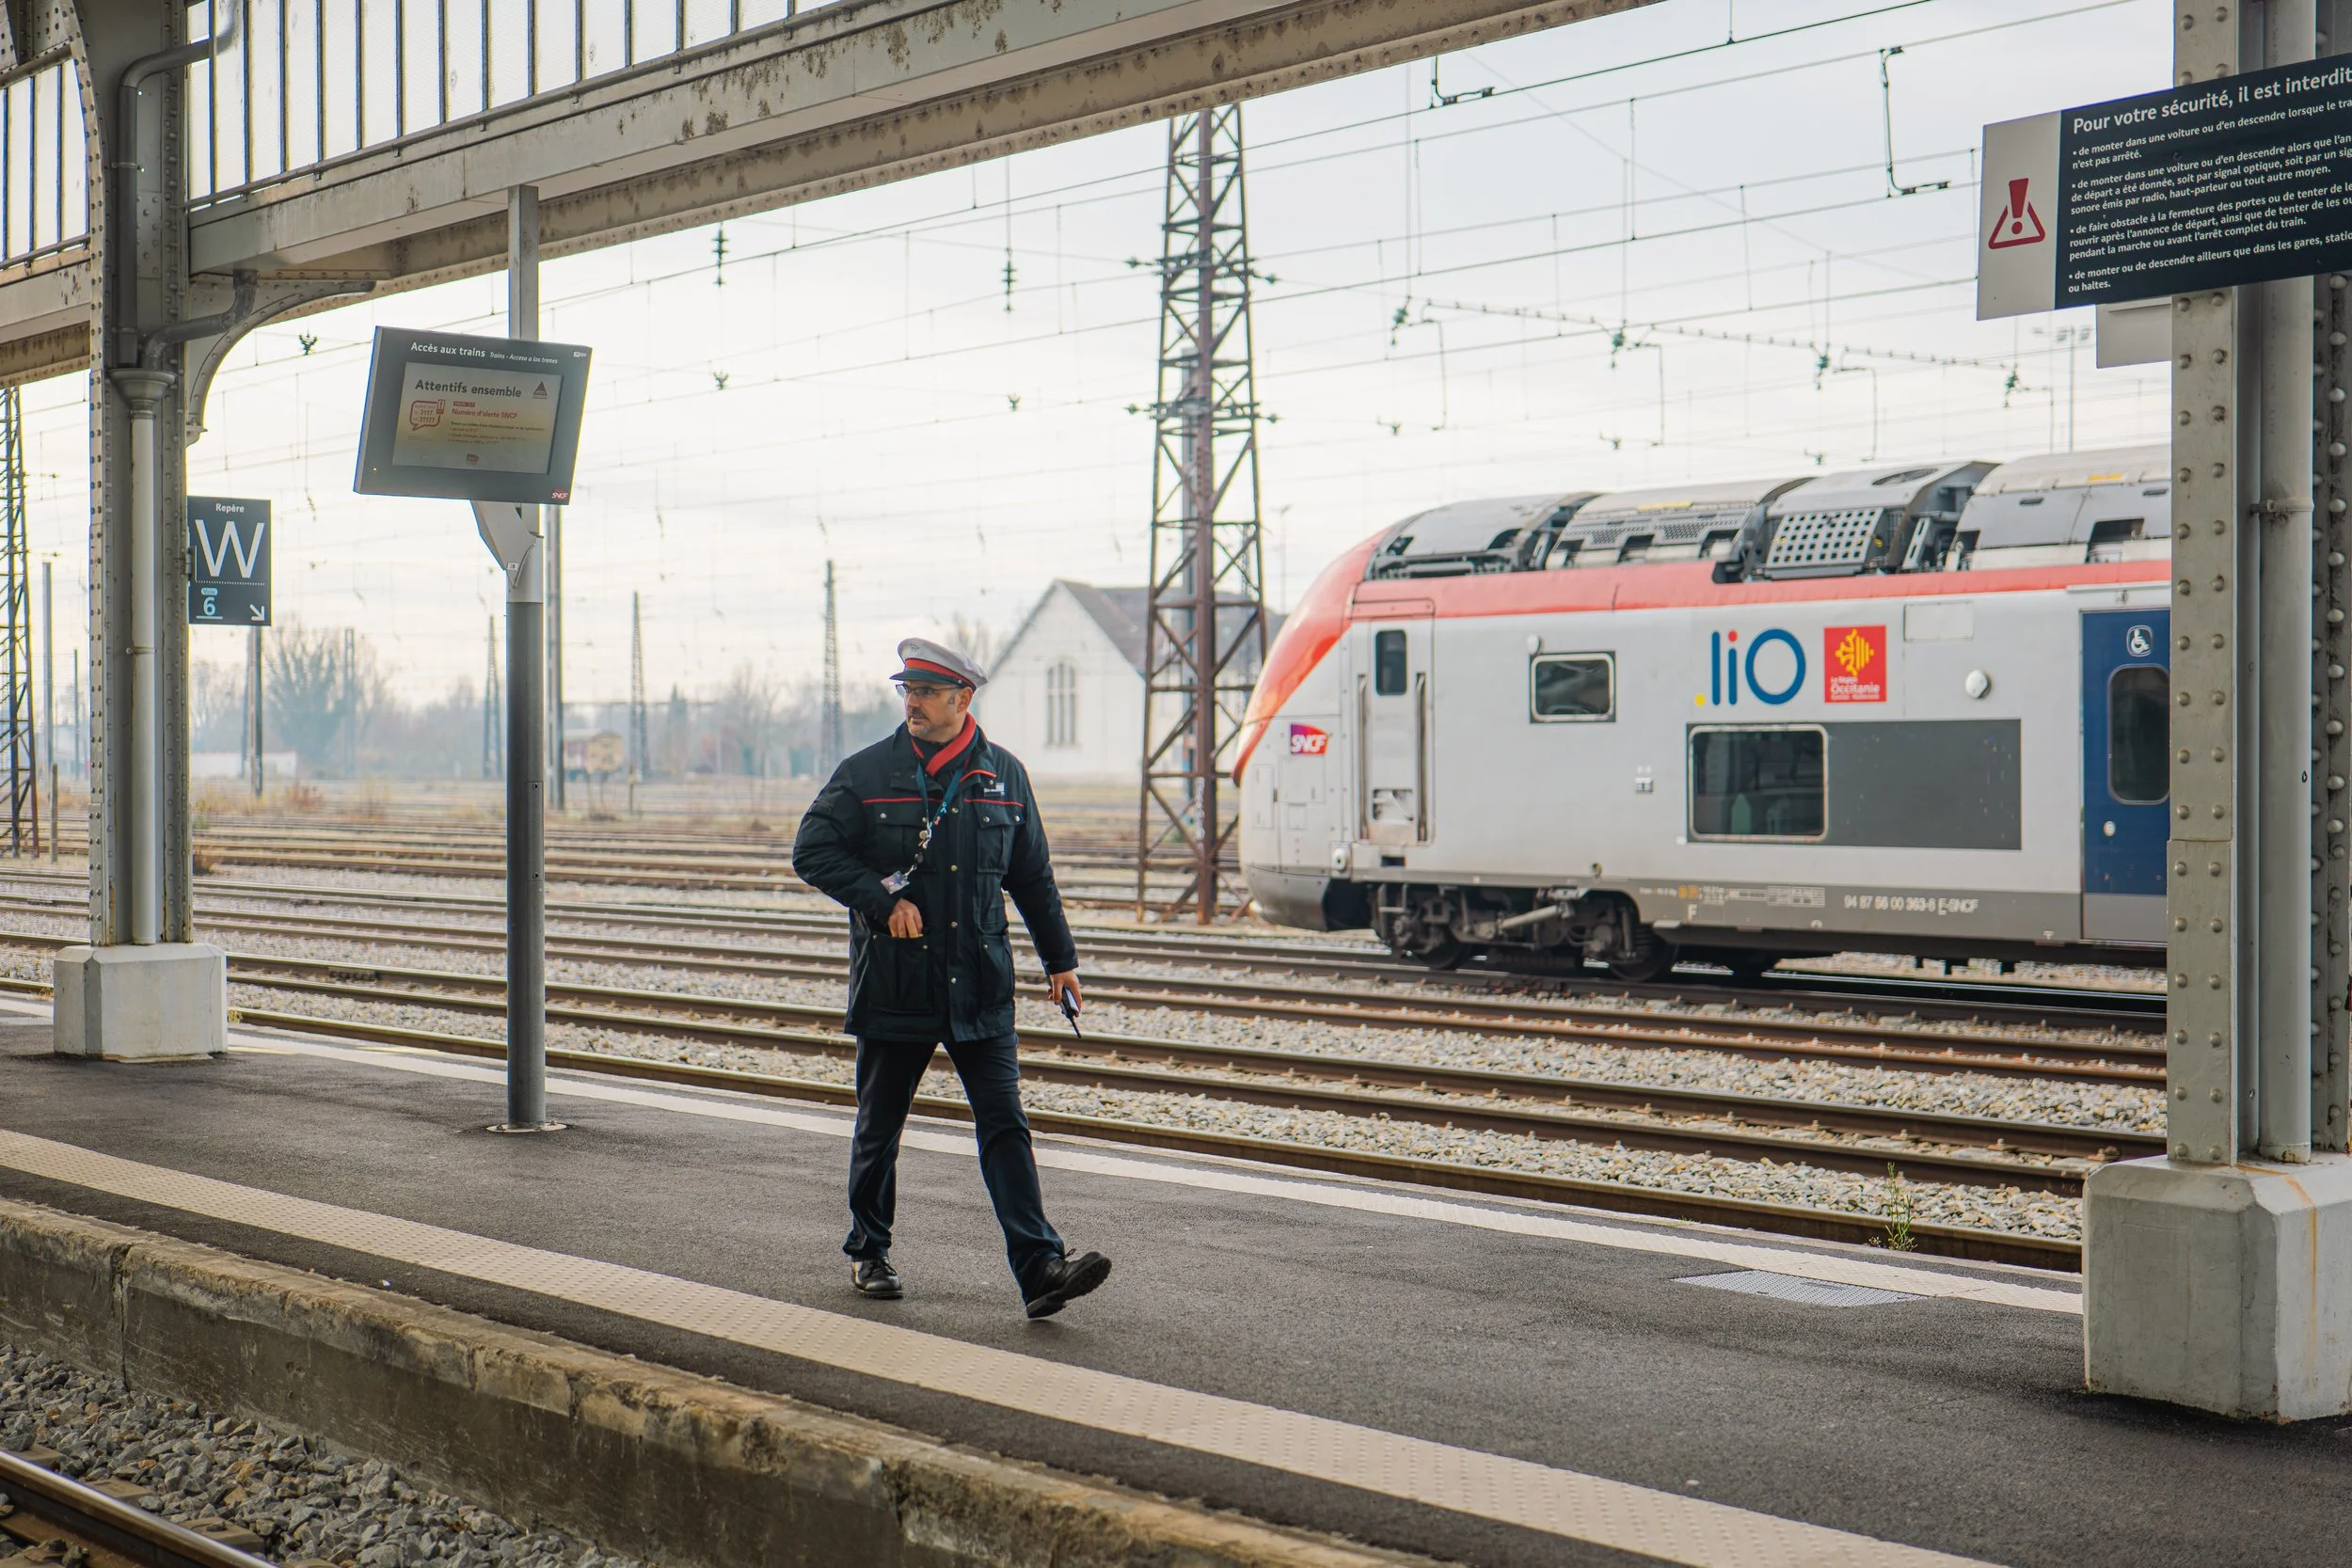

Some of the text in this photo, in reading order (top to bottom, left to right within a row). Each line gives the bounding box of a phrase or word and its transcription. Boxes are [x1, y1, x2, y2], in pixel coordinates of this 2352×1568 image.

[2074, 67, 2352, 134] Pour votre sécurité, il est interdit
[2078, 146, 2090, 155] de
[2090, 141, 2123, 153] monter
[2125, 136, 2146, 147] dans
[2148, 134, 2165, 143] une
[2167, 127, 2200, 139] voiture
[2201, 124, 2213, 133] ou
[2216, 120, 2234, 131] d'en
[2237, 111, 2285, 126] descendre
[2288, 104, 2324, 118] lorsque
[2327, 101, 2335, 110] le
[2072, 149, 2141, 169] n'est pas arrêté.
[2076, 135, 2351, 188] de monter dans une voiture ou d'en descendre alors que l'an
[2071, 193, 2082, 202] de
[2083, 187, 2113, 200] départ
[2122, 182, 2137, 194] été
[2138, 177, 2174, 190] donnée,
[2177, 173, 2194, 184] soit
[2196, 172, 2212, 183] par
[2214, 165, 2241, 179] signal
[2243, 160, 2282, 174] optique,
[2284, 155, 2303, 166] soit
[2305, 153, 2321, 165] par
[2324, 150, 2336, 159] un
[2071, 166, 2330, 214] sonore émis par radio, haut-parleur ou tout autre moyen.
[2075, 225, 2087, 233] de
[2088, 221, 2108, 231] faire
[2110, 214, 2148, 228] obstacle
[2150, 213, 2155, 222] à
[2157, 212, 2166, 221] la
[2168, 205, 2215, 218] fermeture
[2217, 201, 2233, 212] des
[2235, 197, 2265, 211] portes
[2267, 195, 2280, 203] ou
[2282, 191, 2295, 201] de
[2296, 187, 2328, 198] tenter
[2329, 183, 2342, 193] de
[2069, 234, 2099, 247] rouvrir
[2100, 230, 2124, 244] après
[2126, 225, 2169, 238] l'annonce
[2171, 221, 2183, 231] de
[2185, 216, 2218, 230] départ,
[2220, 212, 2242, 224] ainsi
[2244, 211, 2262, 222] que
[2264, 207, 2276, 216] de
[2279, 203, 2309, 214] tenter
[2311, 199, 2323, 210] de
[2326, 198, 2340, 207] les
[2069, 246, 2106, 261] pendant
[2106, 245, 2116, 254] la
[2117, 240, 2151, 252] marche
[2166, 233, 2192, 245] avant
[2194, 229, 2222, 241] l'arrêt
[2224, 222, 2264, 236] complet
[2265, 220, 2278, 230] du
[2280, 216, 2306, 228] train.
[2074, 270, 2085, 279] de
[2087, 266, 2120, 277] monter
[2122, 264, 2133, 273] ou
[2135, 261, 2146, 270] de
[2148, 254, 2195, 268] descendre
[2196, 250, 2231, 261] ailleurs
[2233, 247, 2250, 258] que
[2252, 244, 2275, 253] dans
[2278, 240, 2292, 249] les
[2294, 237, 2322, 249] gares,
[2068, 280, 2111, 293] ou haltes.
[411, 342, 486, 357] Accès aux trains
[509, 354, 528, 362] Acceso
[415, 379, 522, 398] Attentifs ensemble
[452, 408, 476, 418] Numéro
[501, 411, 518, 420] SNCF
[551, 491, 569, 499] SNCF
[215, 503, 246, 515] Repère
[195, 518, 265, 578] W
[203, 596, 216, 616] 6
[1831, 682, 1880, 695] Occitanie
[1291, 734, 1327, 753] SNCF
